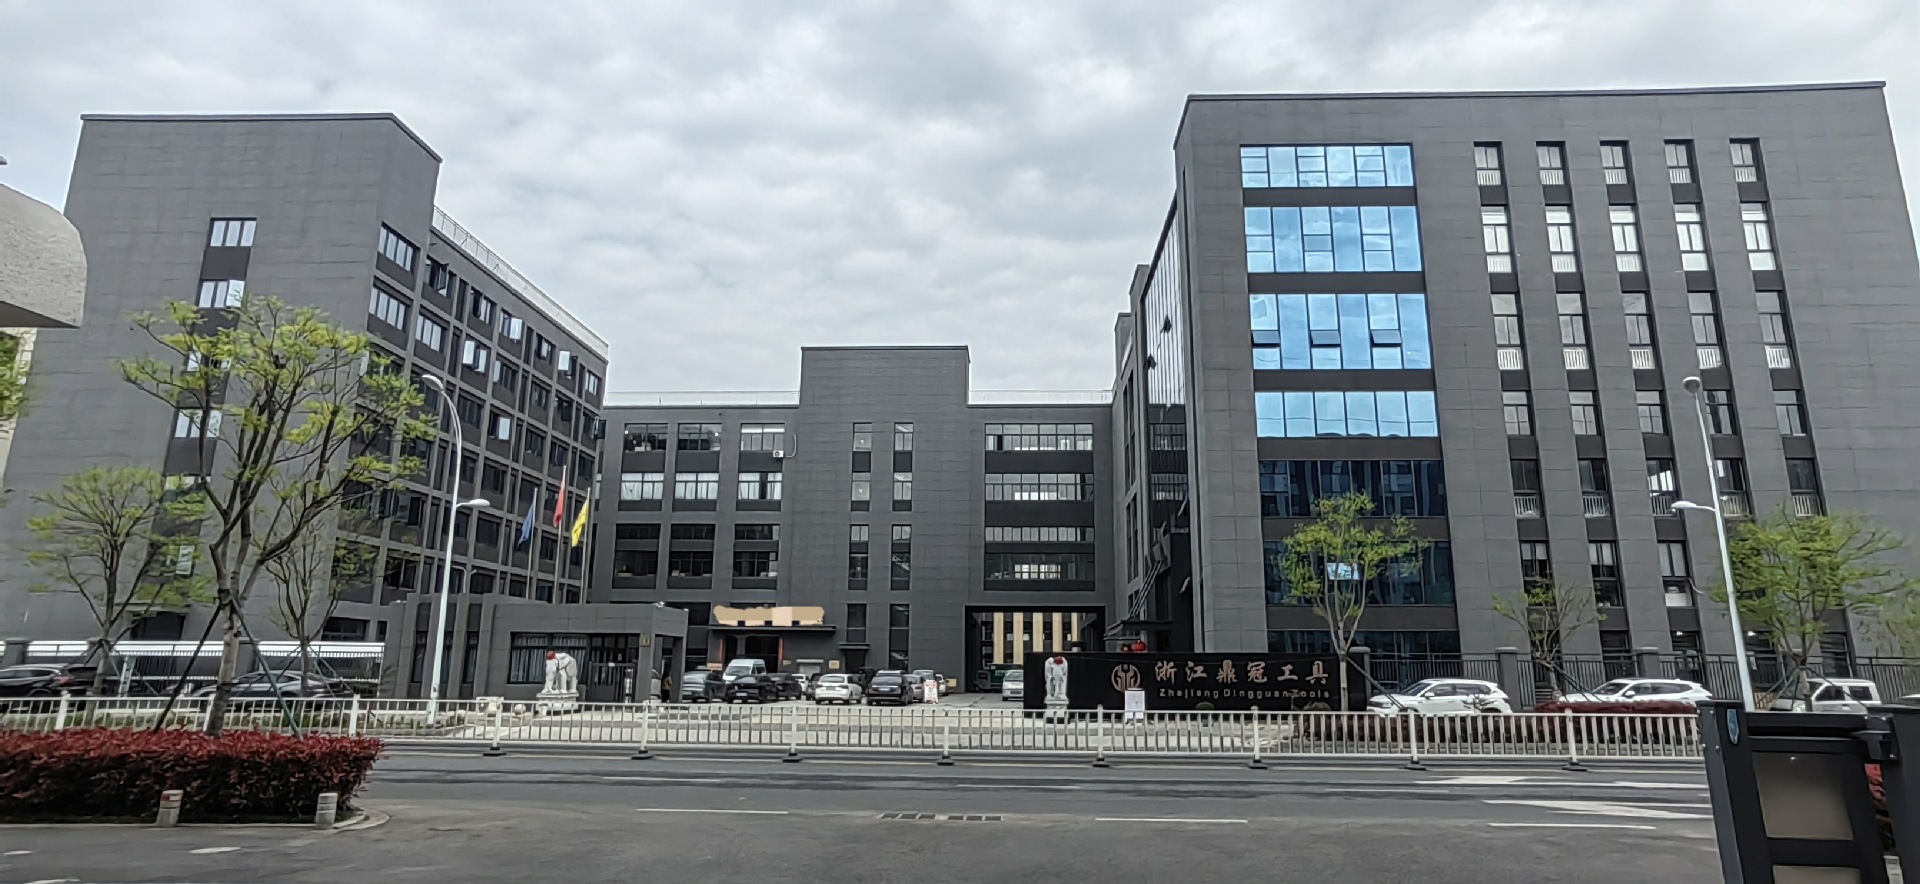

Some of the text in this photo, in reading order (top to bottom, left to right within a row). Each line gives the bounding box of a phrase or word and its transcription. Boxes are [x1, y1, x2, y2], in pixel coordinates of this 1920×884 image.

[1155, 660, 1328, 684] 浙江鼎冠工具
[1159, 688, 1219, 699] Zhejiang
[1223, 688, 1289, 699] Dingguan
